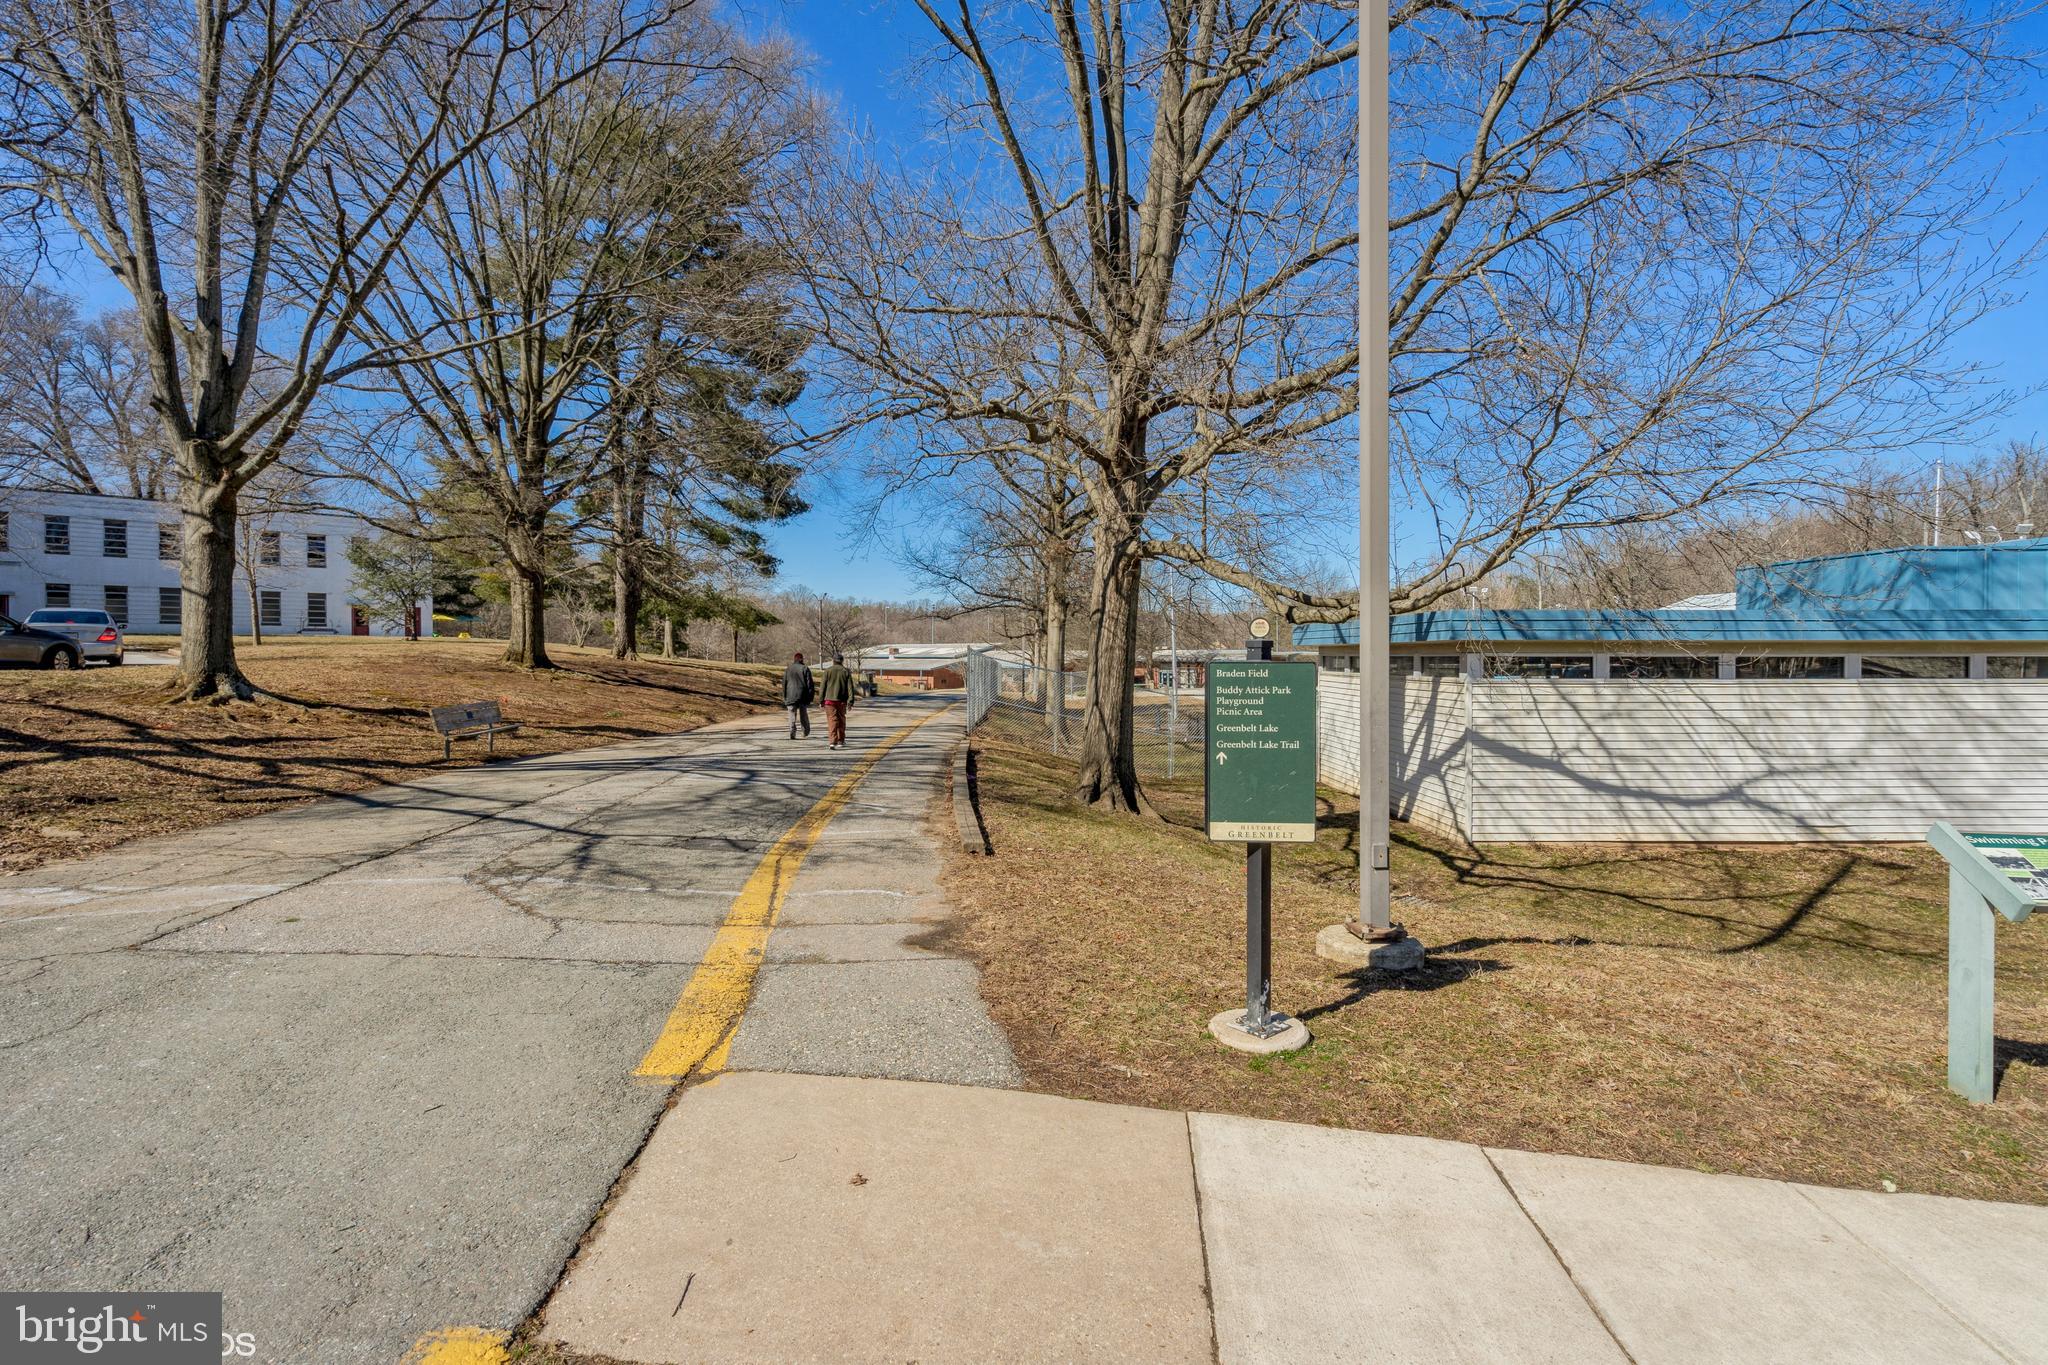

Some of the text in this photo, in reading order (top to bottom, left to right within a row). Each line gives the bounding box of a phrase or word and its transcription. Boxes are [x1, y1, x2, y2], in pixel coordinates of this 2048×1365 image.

[1216, 669, 1269, 678] Braden Field
[1216, 686, 1292, 696] Buddy Attick Park
[1216, 697, 1264, 707] Playground
[1216, 707, 1263, 716] Picnic Area
[1216, 724, 1279, 732] Greenbelt Lake
[1216, 740, 1300, 749] Greenbelt Lake Trail
[1228, 831, 1295, 839] GREENBELT
[1965, 835, 2040, 846] Swimming
